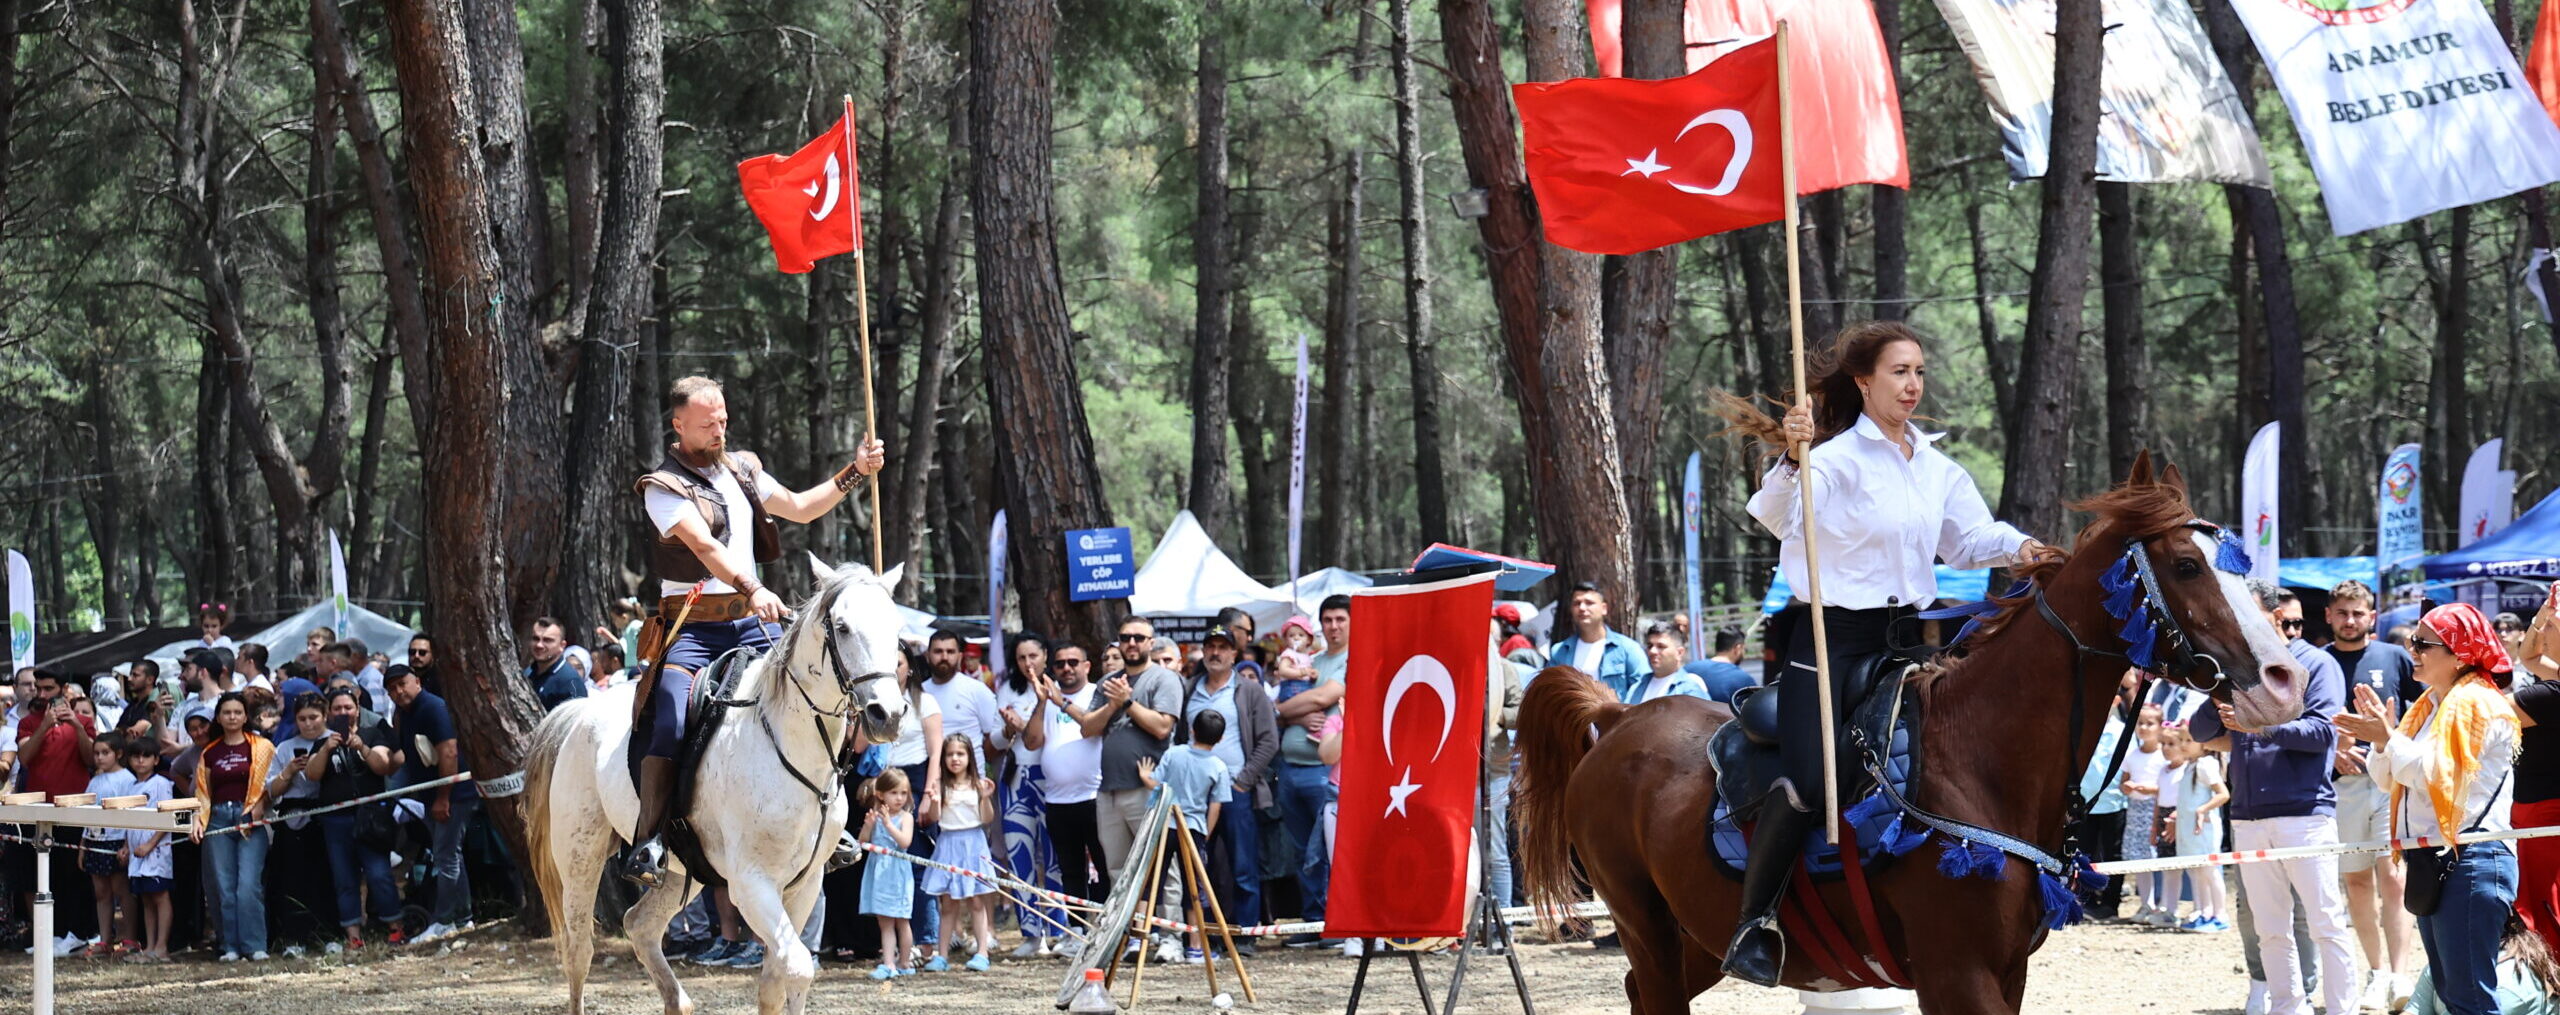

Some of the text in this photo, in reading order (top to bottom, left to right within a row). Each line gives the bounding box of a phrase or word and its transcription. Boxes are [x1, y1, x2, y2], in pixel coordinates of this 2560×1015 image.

[2327, 31, 2463, 73] ANAMUR
[2326, 66, 2513, 123] BELEDİYESİ
[1079, 553, 1123, 567] YERLERE
[2546, 557, 2560, 575] B
[1091, 566, 1113, 580] ÇÖP
[1077, 579, 1129, 593] ATMAYALIM
